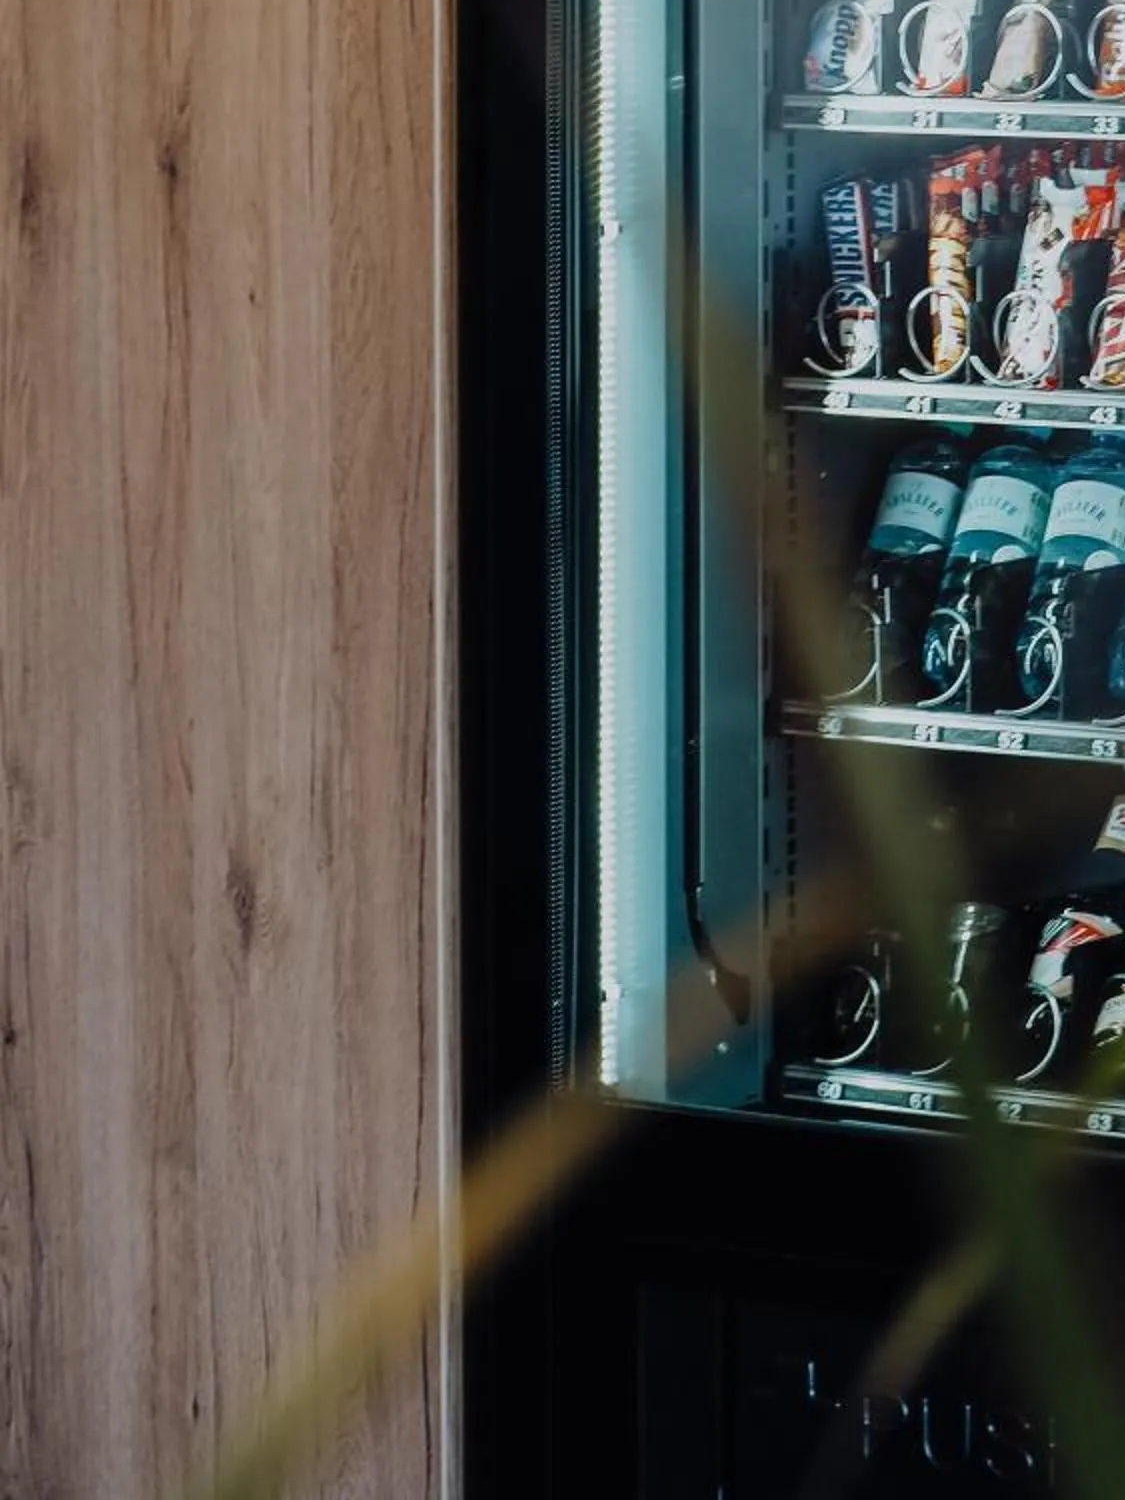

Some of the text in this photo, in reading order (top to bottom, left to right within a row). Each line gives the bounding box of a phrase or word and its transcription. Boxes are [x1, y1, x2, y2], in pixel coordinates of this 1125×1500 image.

[913, 111, 938, 128] 31
[996, 114, 1021, 132] 32
[1093, 116, 1119, 134] 33
[906, 397, 931, 412] 41
[994, 401, 1023, 419] 42
[1089, 407, 1117, 424] 43
[915, 724, 939, 742] 51
[998, 731, 1024, 749] 52
[1092, 740, 1117, 757] 53
[817, 1082, 842, 1099] 60
[910, 1093, 932, 1110] 61
[1088, 1114, 1112, 1131] 63
